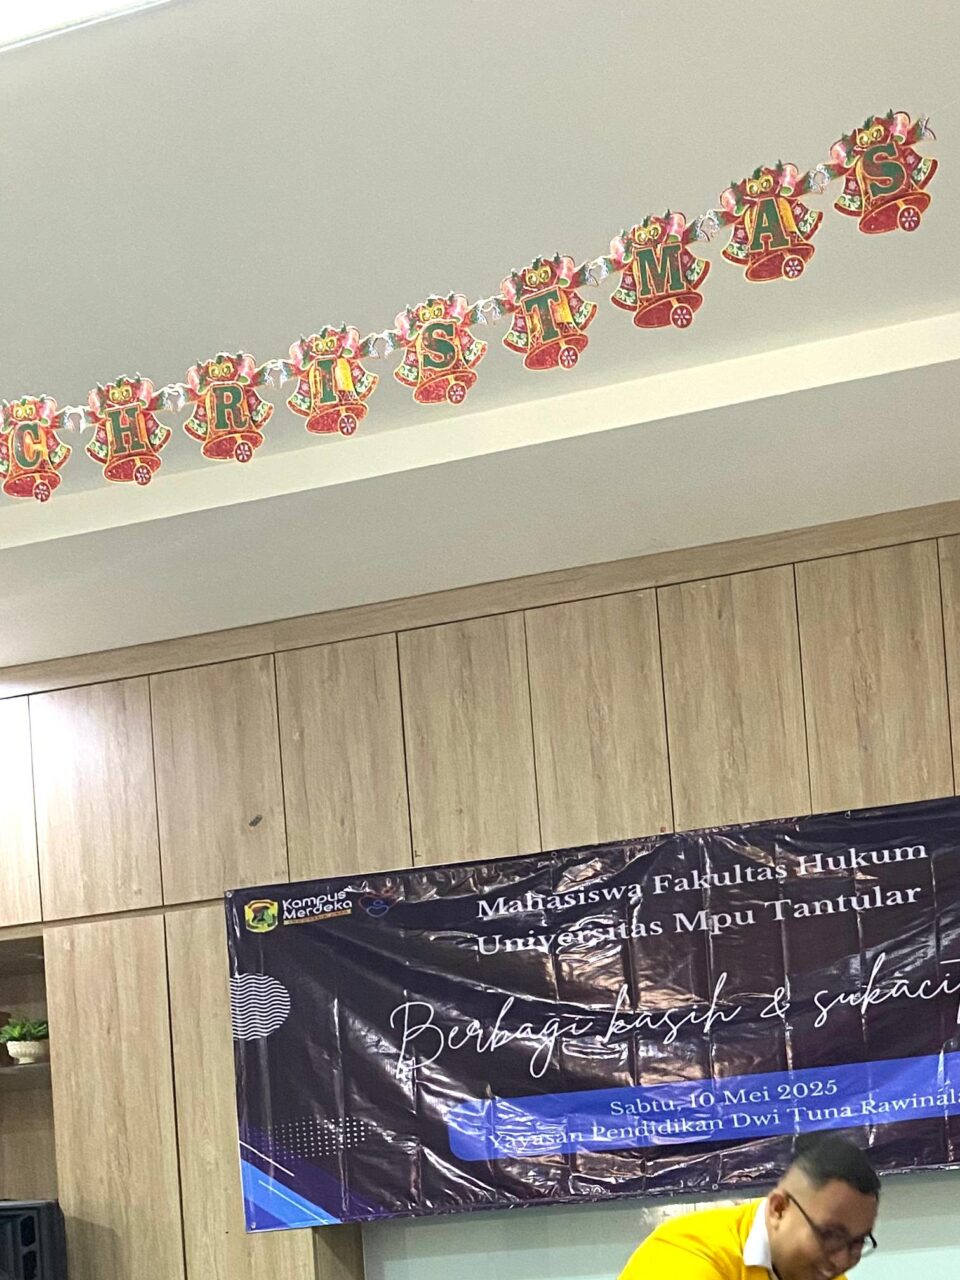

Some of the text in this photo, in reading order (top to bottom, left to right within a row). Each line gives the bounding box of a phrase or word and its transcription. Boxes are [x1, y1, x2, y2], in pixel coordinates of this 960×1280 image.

[282, 891, 346, 911] Kampus
[477, 845, 927, 918] Mahasiswa Fakultas Hukum
[283, 900, 352, 919] Merdeka
[477, 884, 921, 955] Universitas Mpu Tantular
[390, 996, 593, 1079] Berbagi
[600, 972, 741, 1043] kasih
[760, 987, 790, 1018] &
[689, 1092, 715, 1108] 10
[724, 1087, 770, 1106] Mei
[777, 1080, 838, 1100] 2025
[489, 1130, 583, 1150] Yayasan
[592, 1115, 723, 1140] Pendidikan
[731, 1109, 780, 1128] Dwi
[787, 1106, 850, 1123] Tuna
